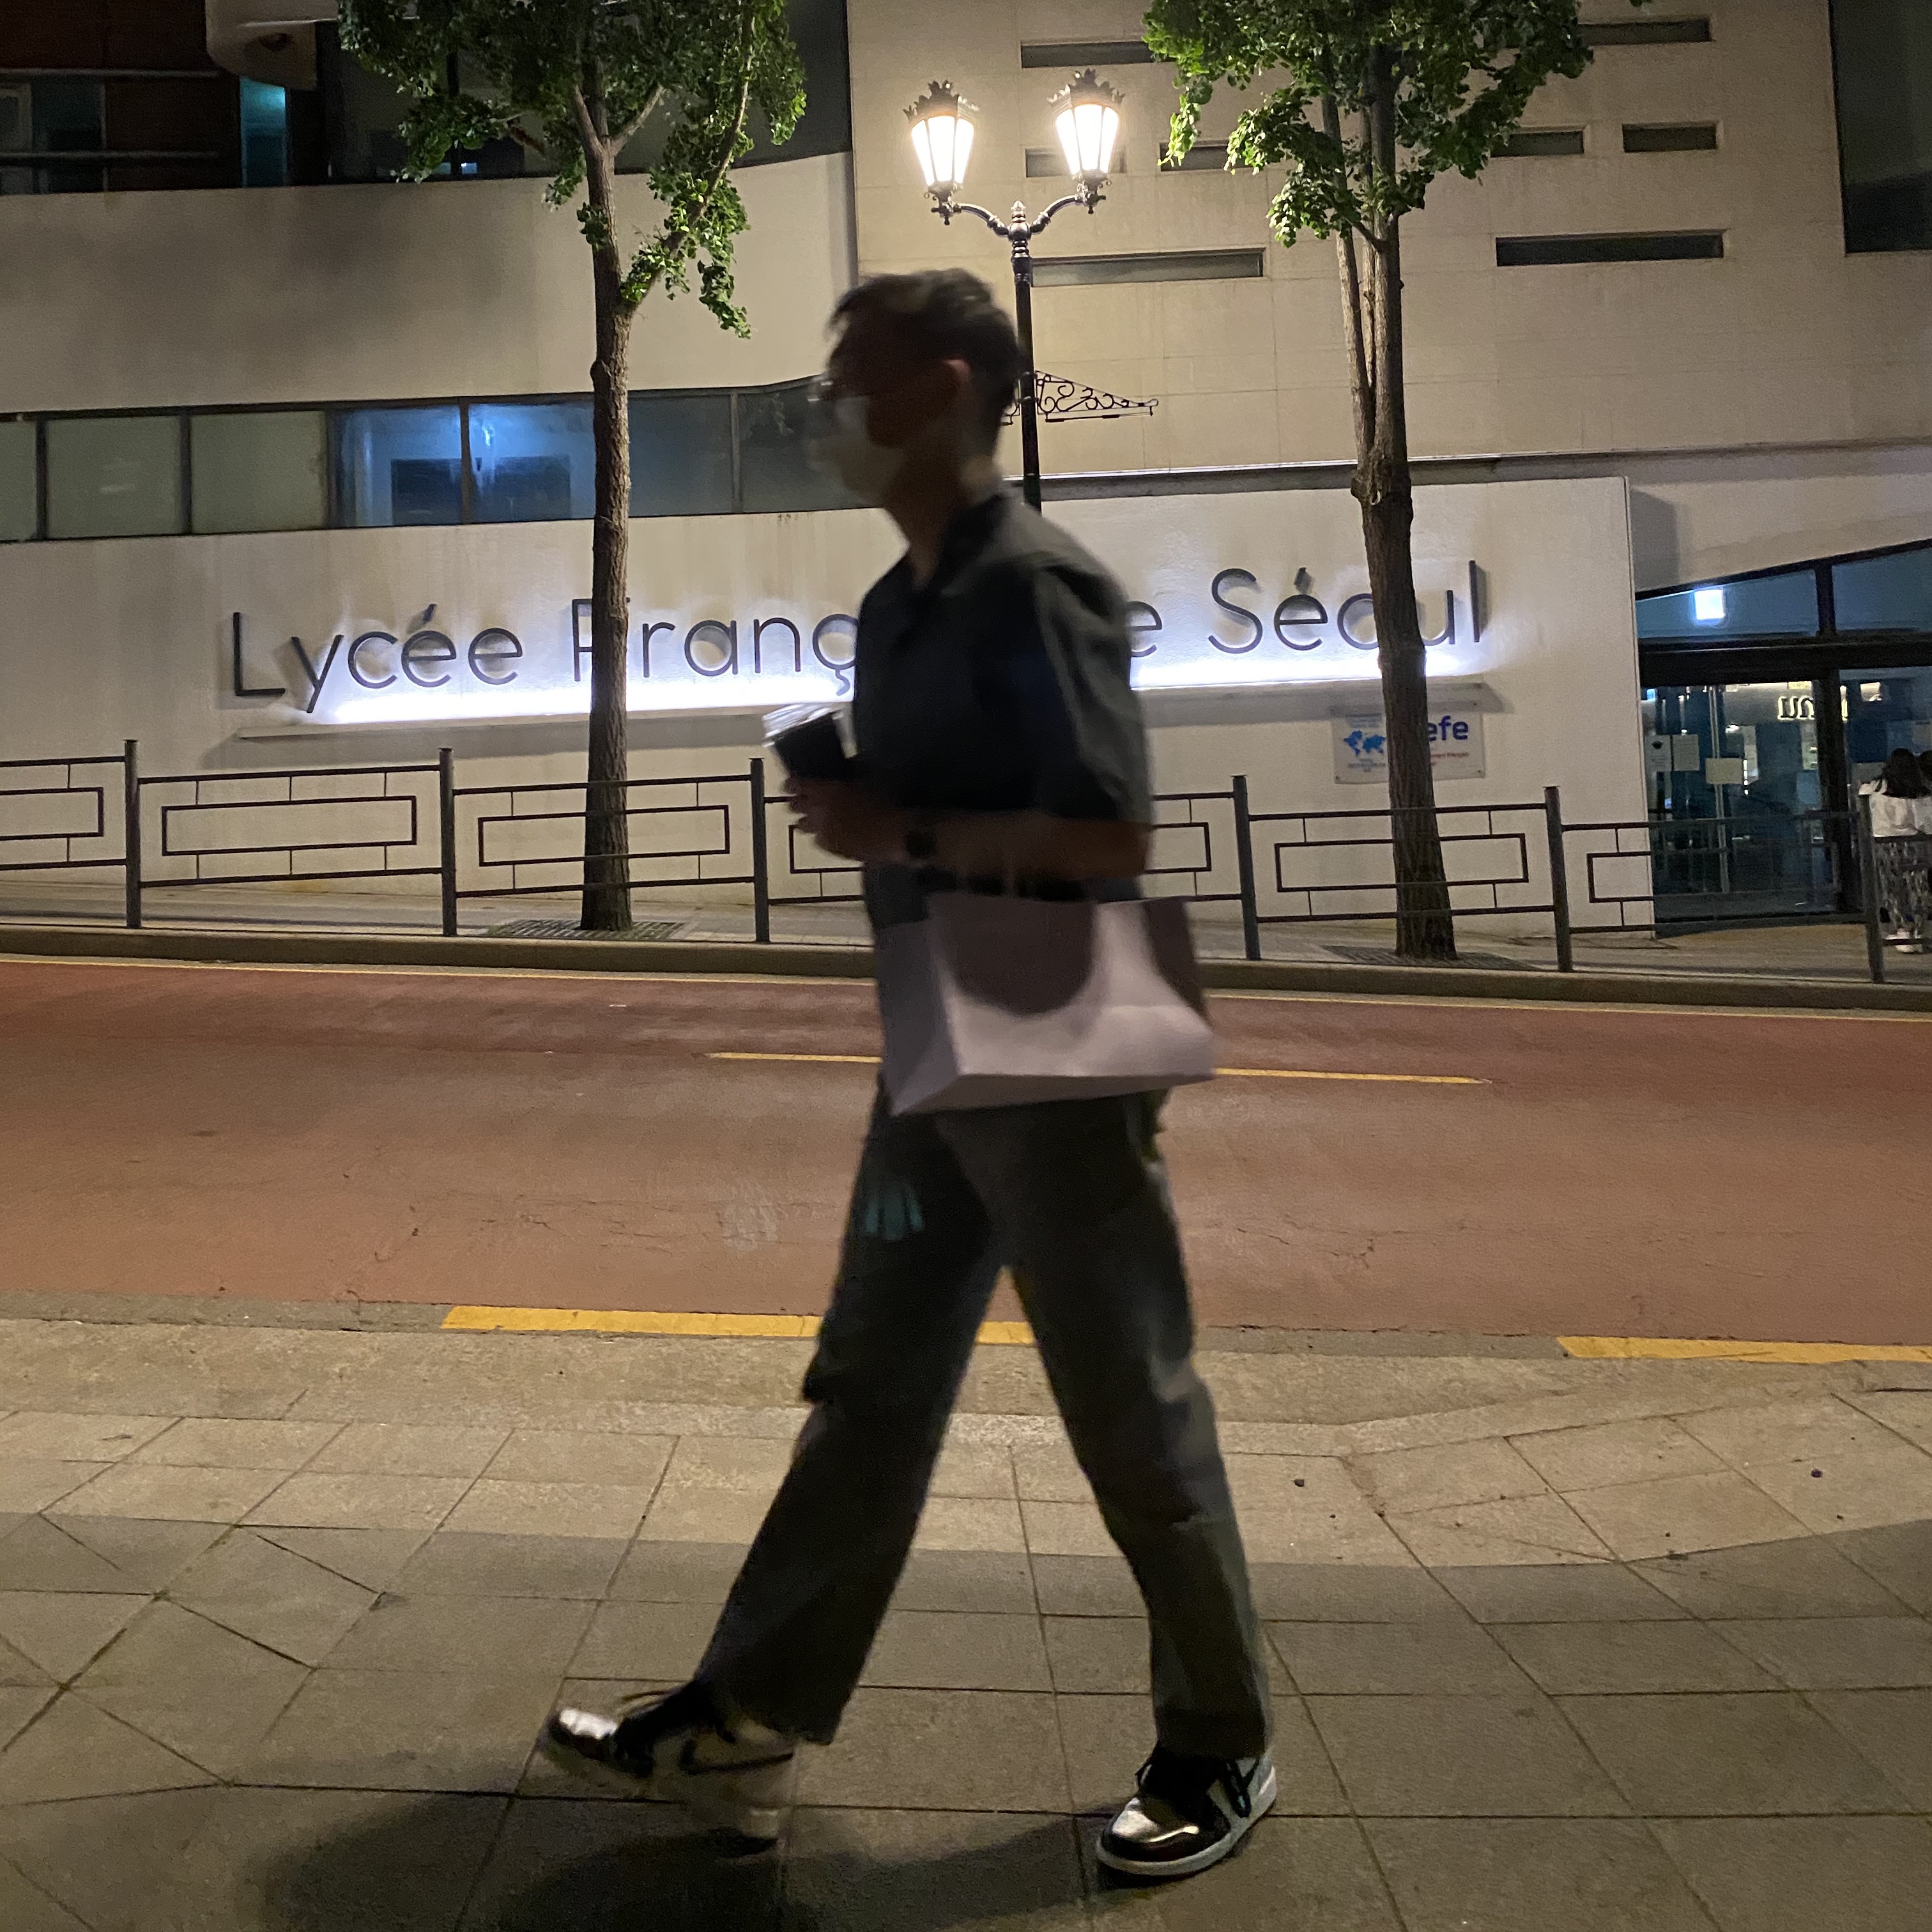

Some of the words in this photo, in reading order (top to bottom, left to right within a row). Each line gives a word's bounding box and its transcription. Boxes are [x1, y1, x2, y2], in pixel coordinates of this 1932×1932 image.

[233, 603, 523, 714] Lycée
[572, 597, 859, 696] Franç
[1124, 601, 1163, 658] e
[1209, 560, 1480, 654] Séoul
